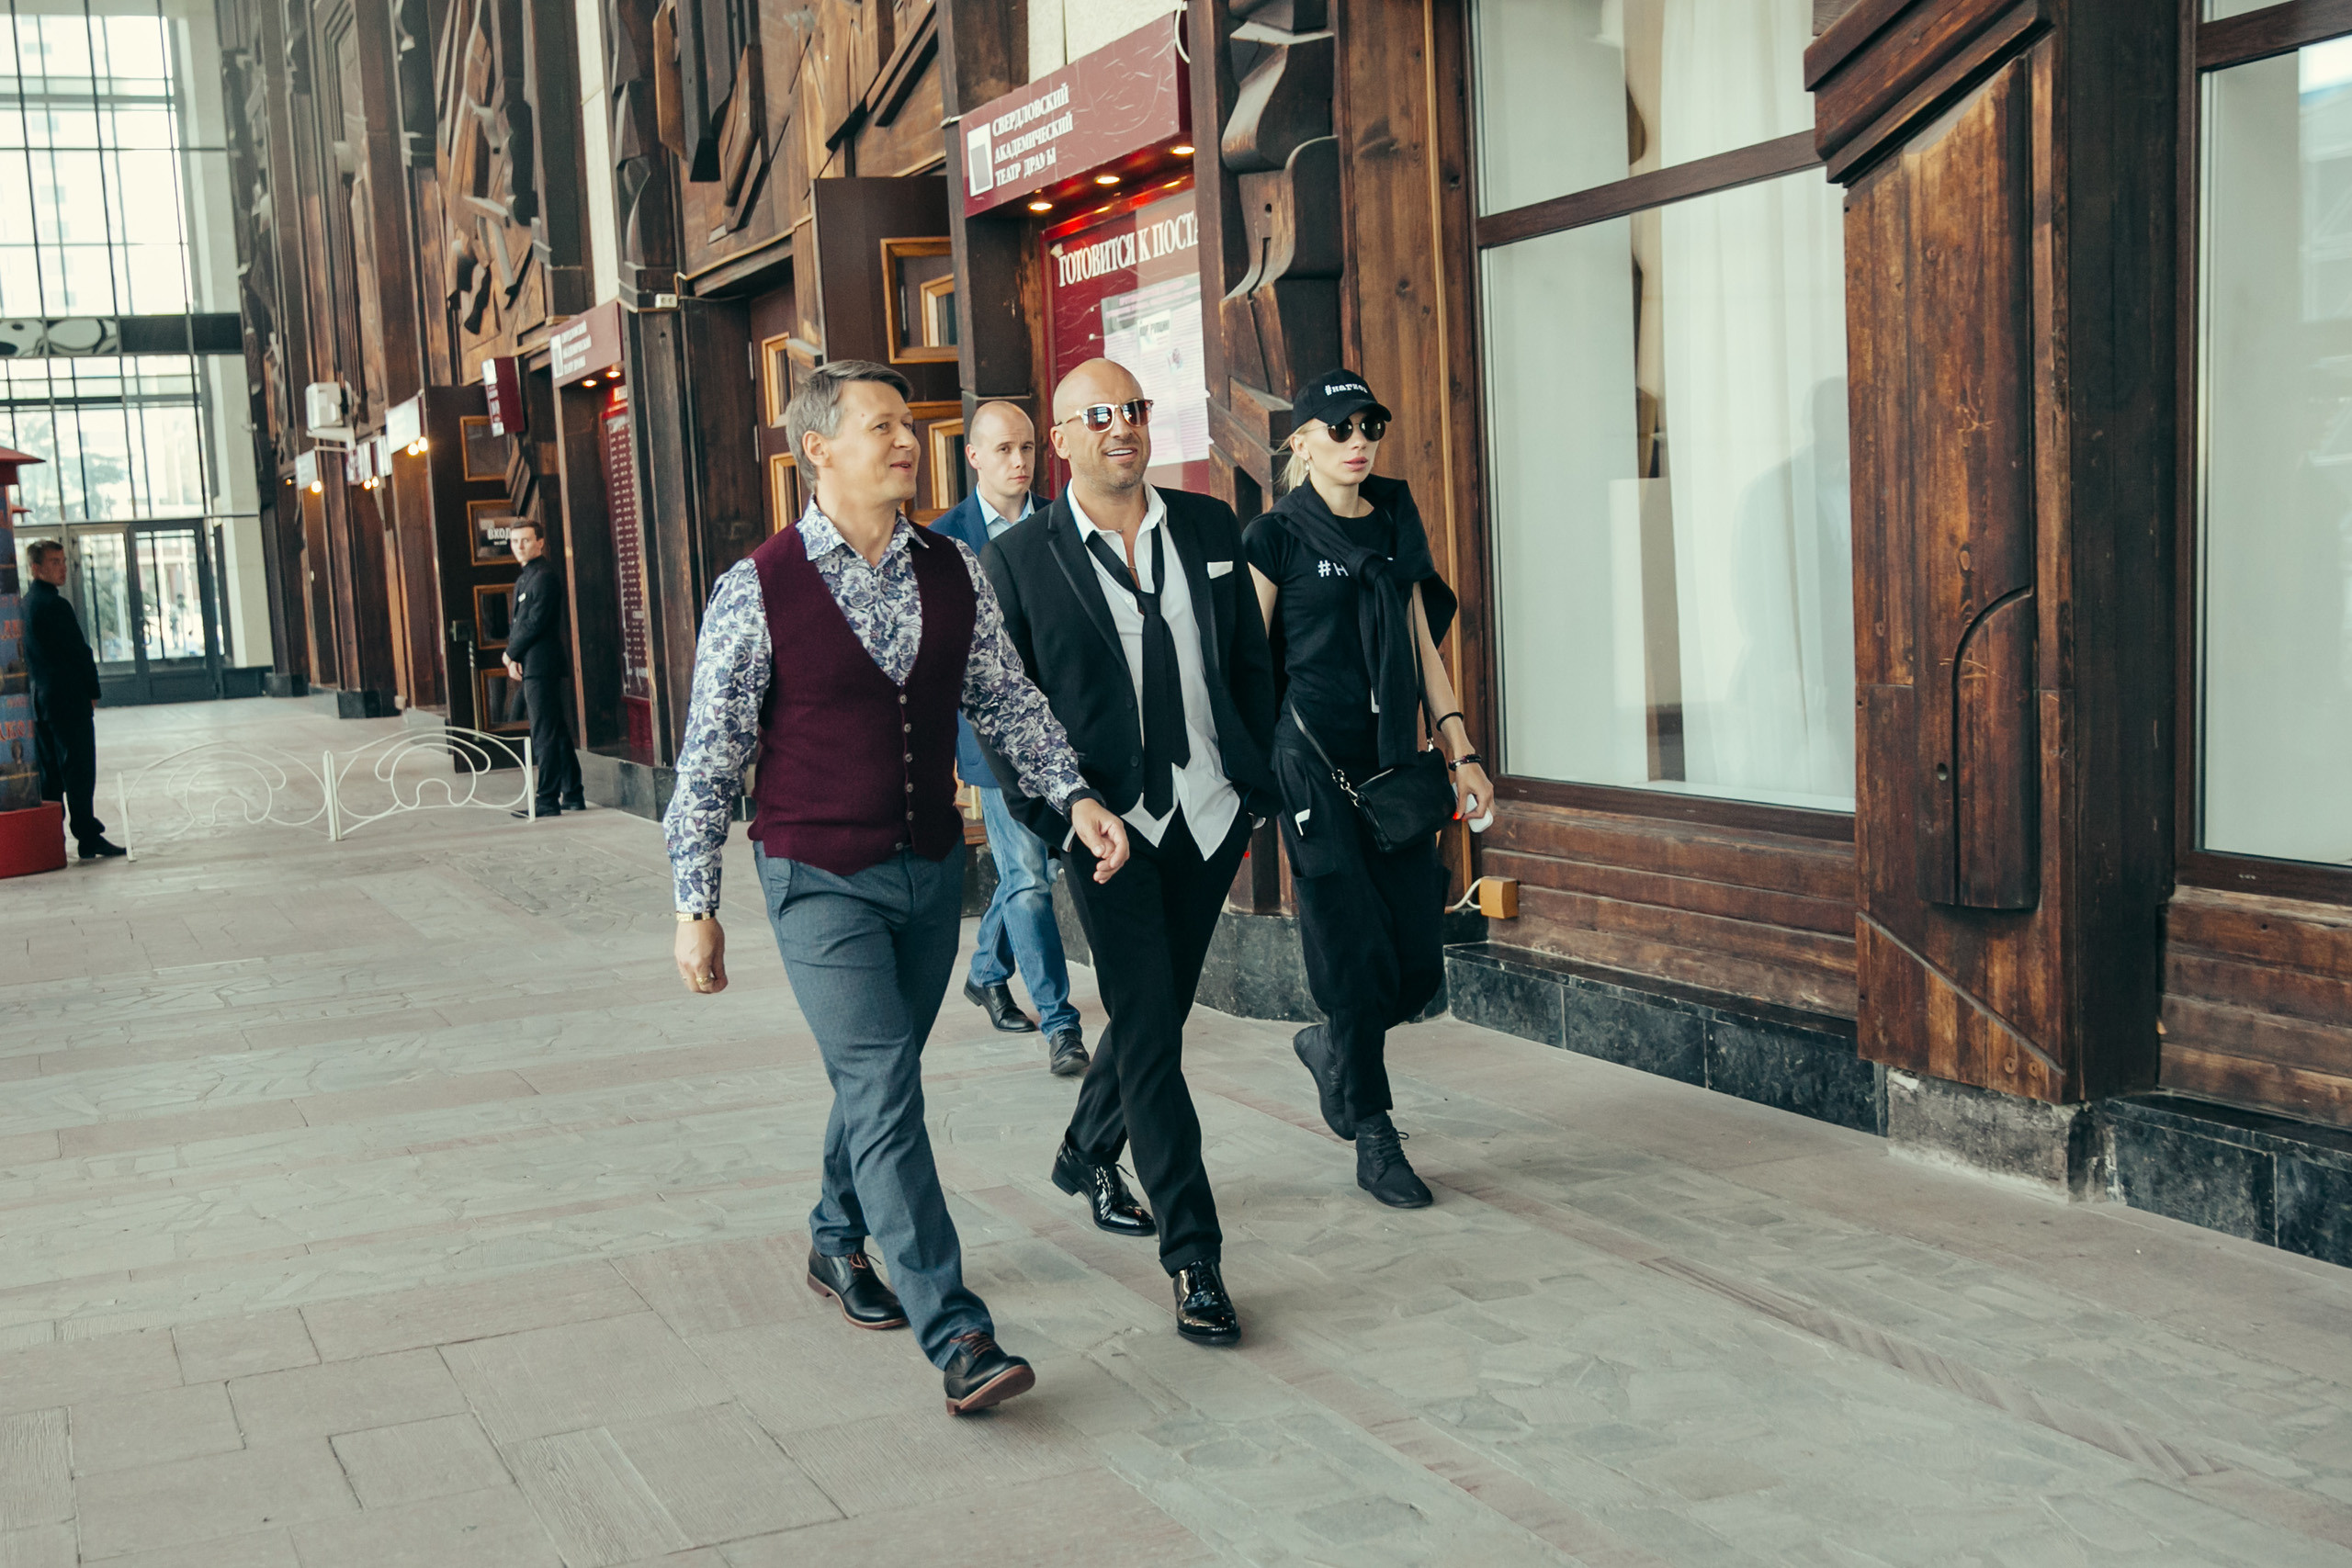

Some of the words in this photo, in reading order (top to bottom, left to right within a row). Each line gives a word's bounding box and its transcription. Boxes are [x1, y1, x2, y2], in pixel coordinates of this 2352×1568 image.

[992, 83, 1069, 137] СВЕРДЛОВСКИЙ
[994, 111, 1073, 164] АКАДЕМИЧЕСКИЙ
[995, 162, 1022, 187] ТЕАТР
[1058, 230, 1136, 288] ГОТОВИТСЯ
[1136, 227, 1151, 263] К
